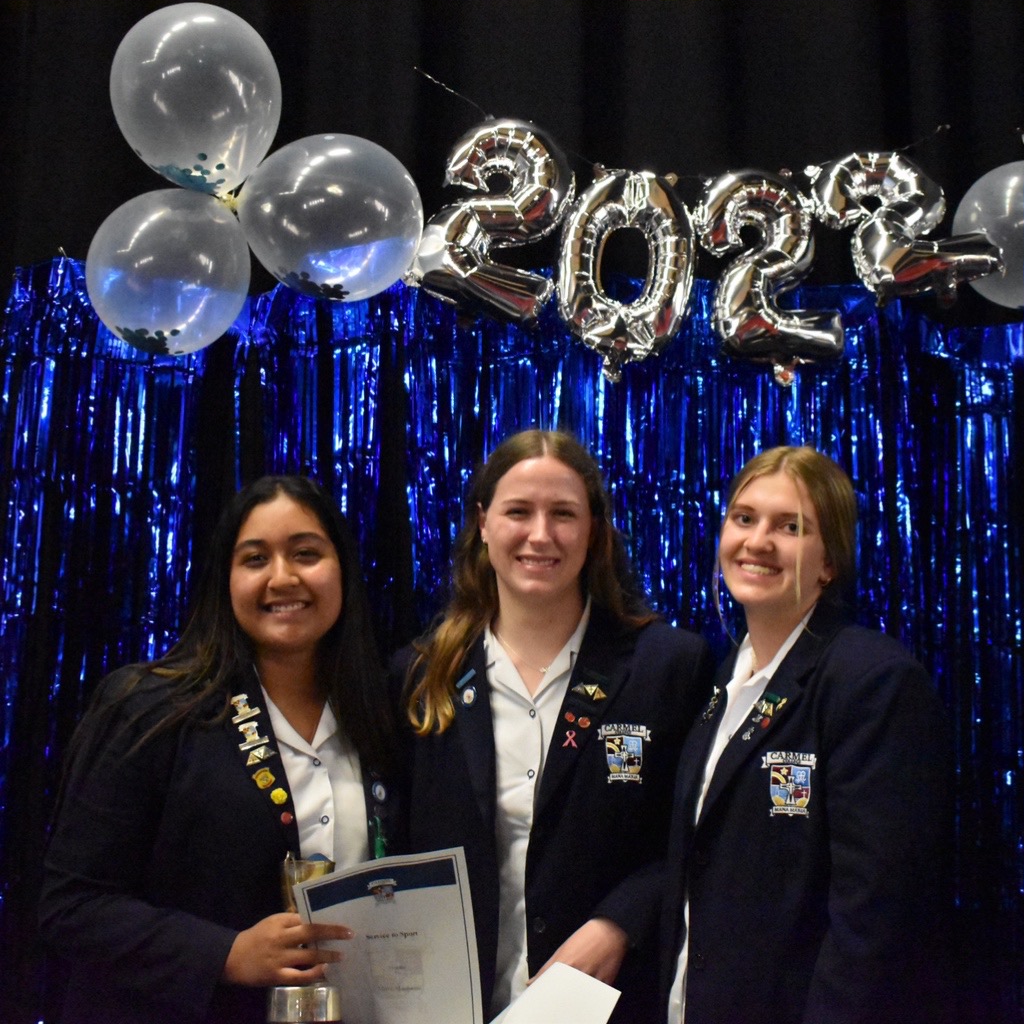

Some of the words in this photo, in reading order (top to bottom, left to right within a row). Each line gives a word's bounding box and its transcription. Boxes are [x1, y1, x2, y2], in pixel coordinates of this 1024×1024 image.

[402, 118, 1004, 364] 2022
[605, 724, 644, 733] CARMEL
[770, 752, 812, 762] CARMEL
